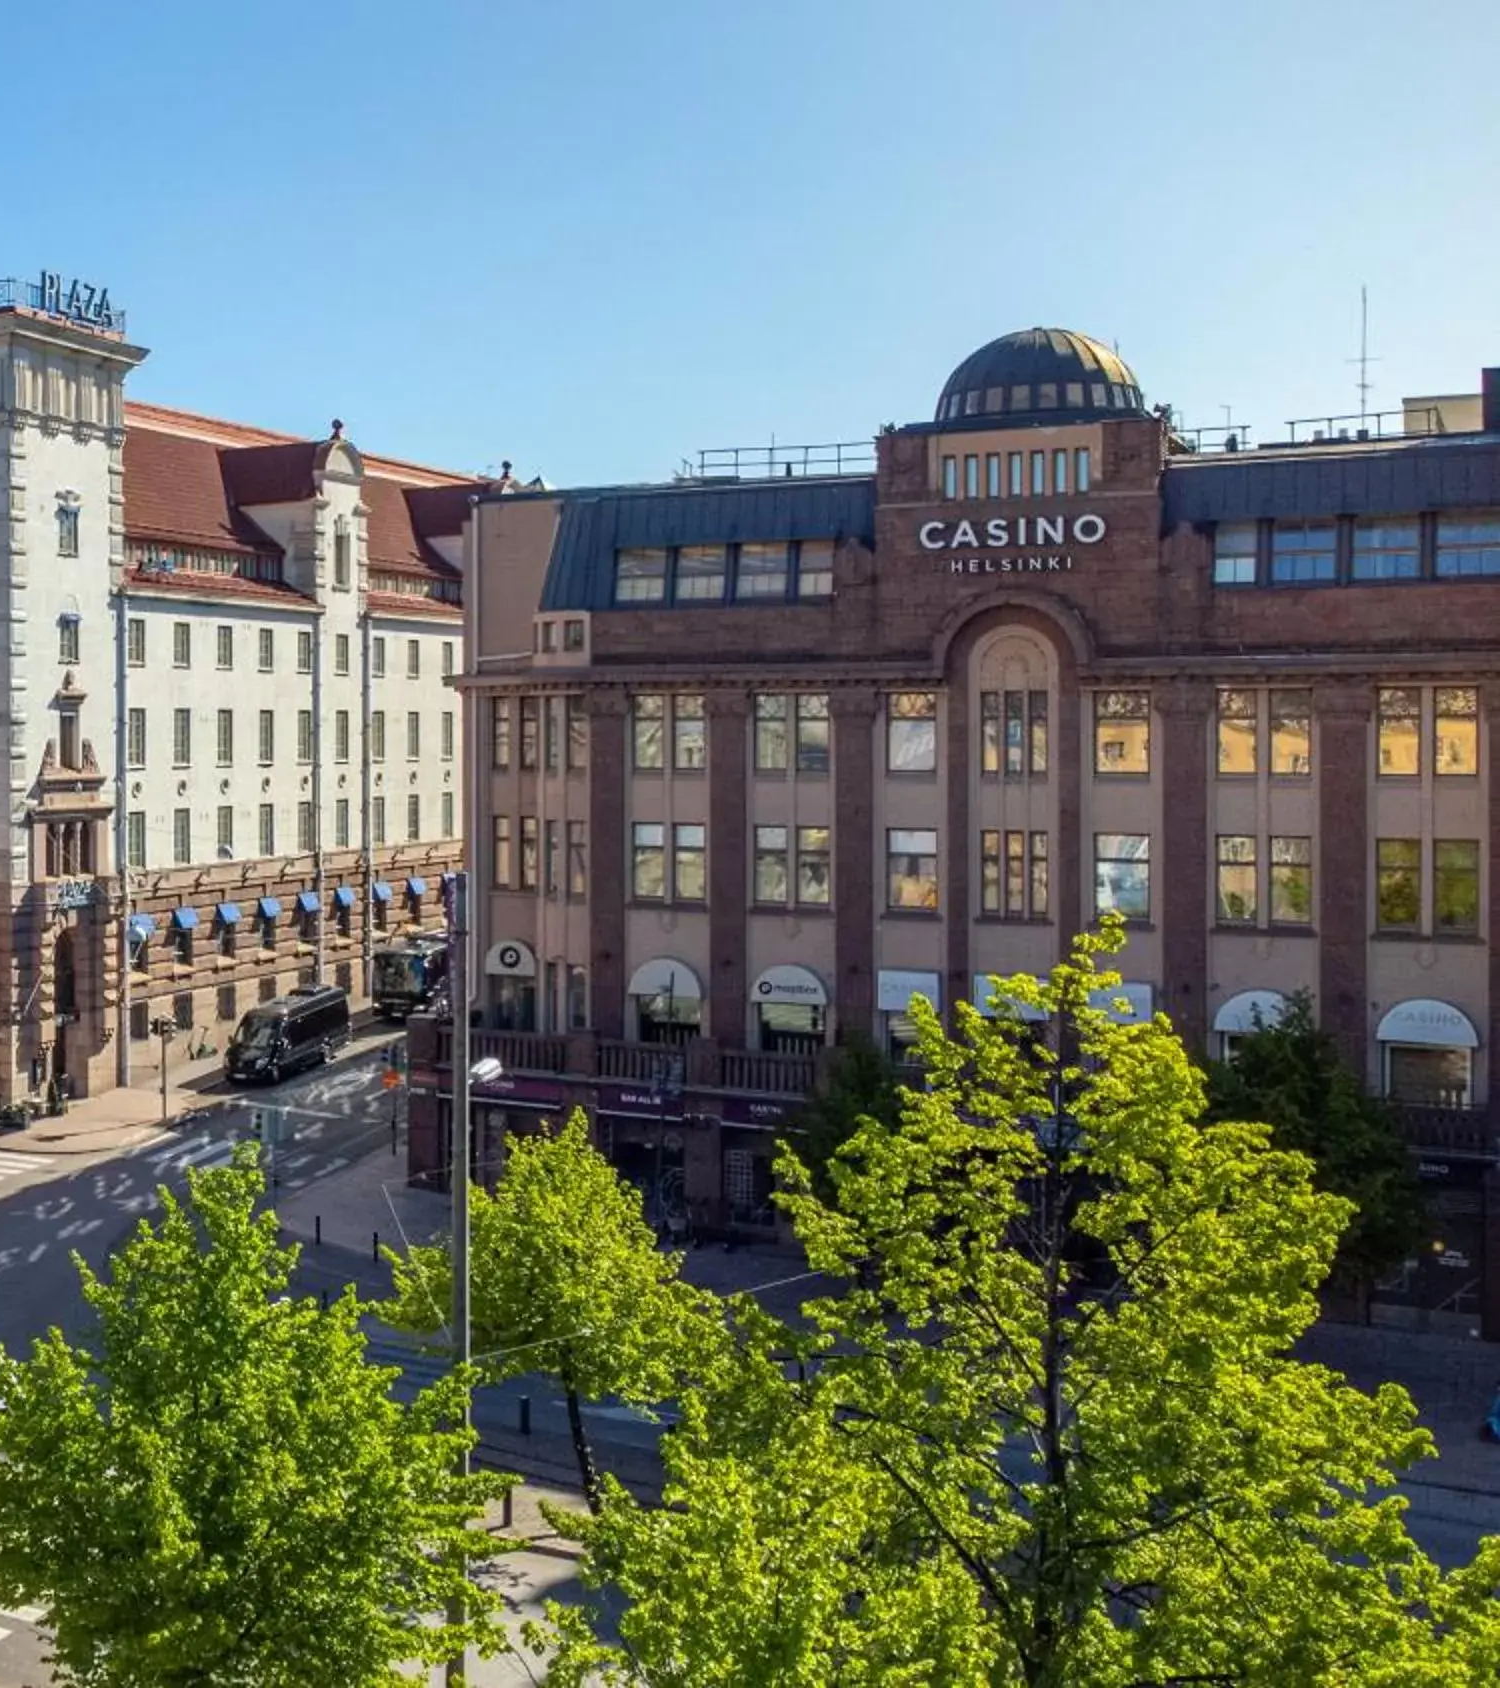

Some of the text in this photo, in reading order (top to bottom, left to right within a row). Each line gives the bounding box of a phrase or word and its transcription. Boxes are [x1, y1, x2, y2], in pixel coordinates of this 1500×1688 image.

[41, 269, 113, 327] PLAZA
[919, 513, 1106, 549] CASINO
[950, 556, 1073, 573] HELSINKI
